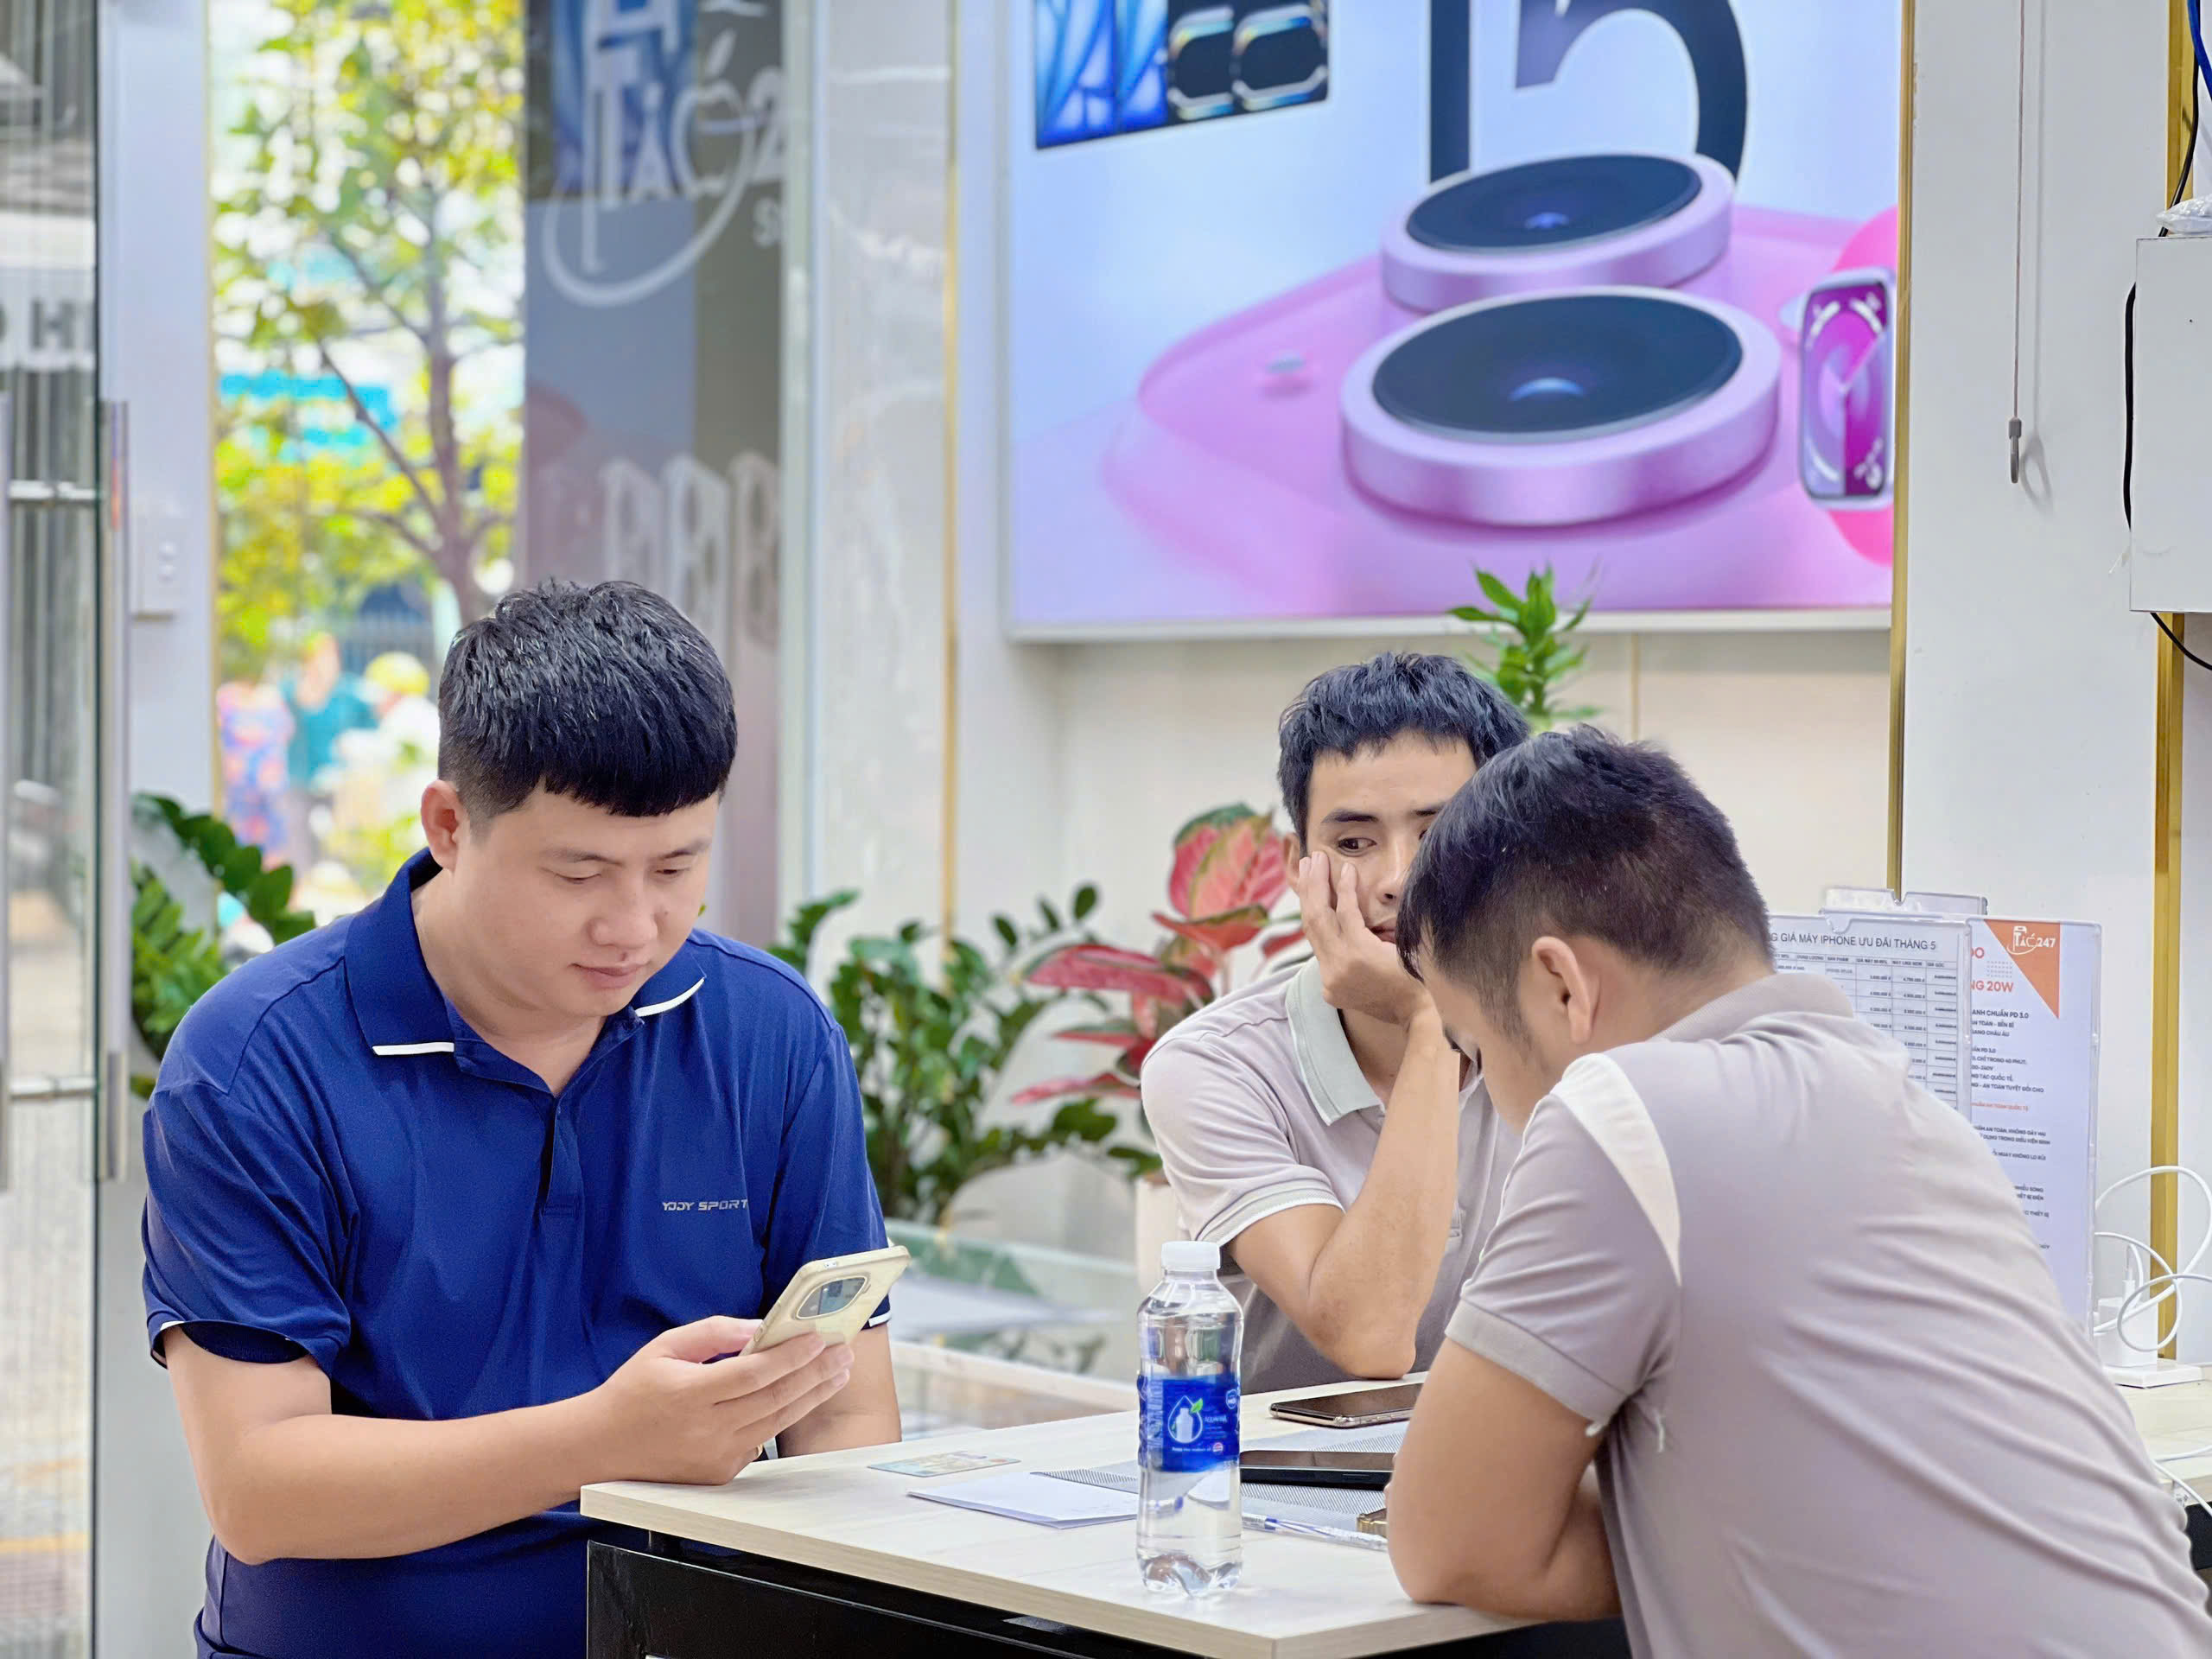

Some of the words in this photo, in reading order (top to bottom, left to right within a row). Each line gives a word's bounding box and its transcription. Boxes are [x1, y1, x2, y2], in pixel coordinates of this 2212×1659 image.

[1781, 931, 1796, 942] GIÁ
[1799, 933, 1818, 944] MÁY
[1821, 935, 1856, 946] IPHONE
[1859, 937, 1873, 947] ƯU
[1894, 938, 1928, 950] THÁNG
[1930, 940, 1936, 950] 5
[1986, 981, 2013, 992] 20W
[698, 1199, 748, 1211] SPORT
